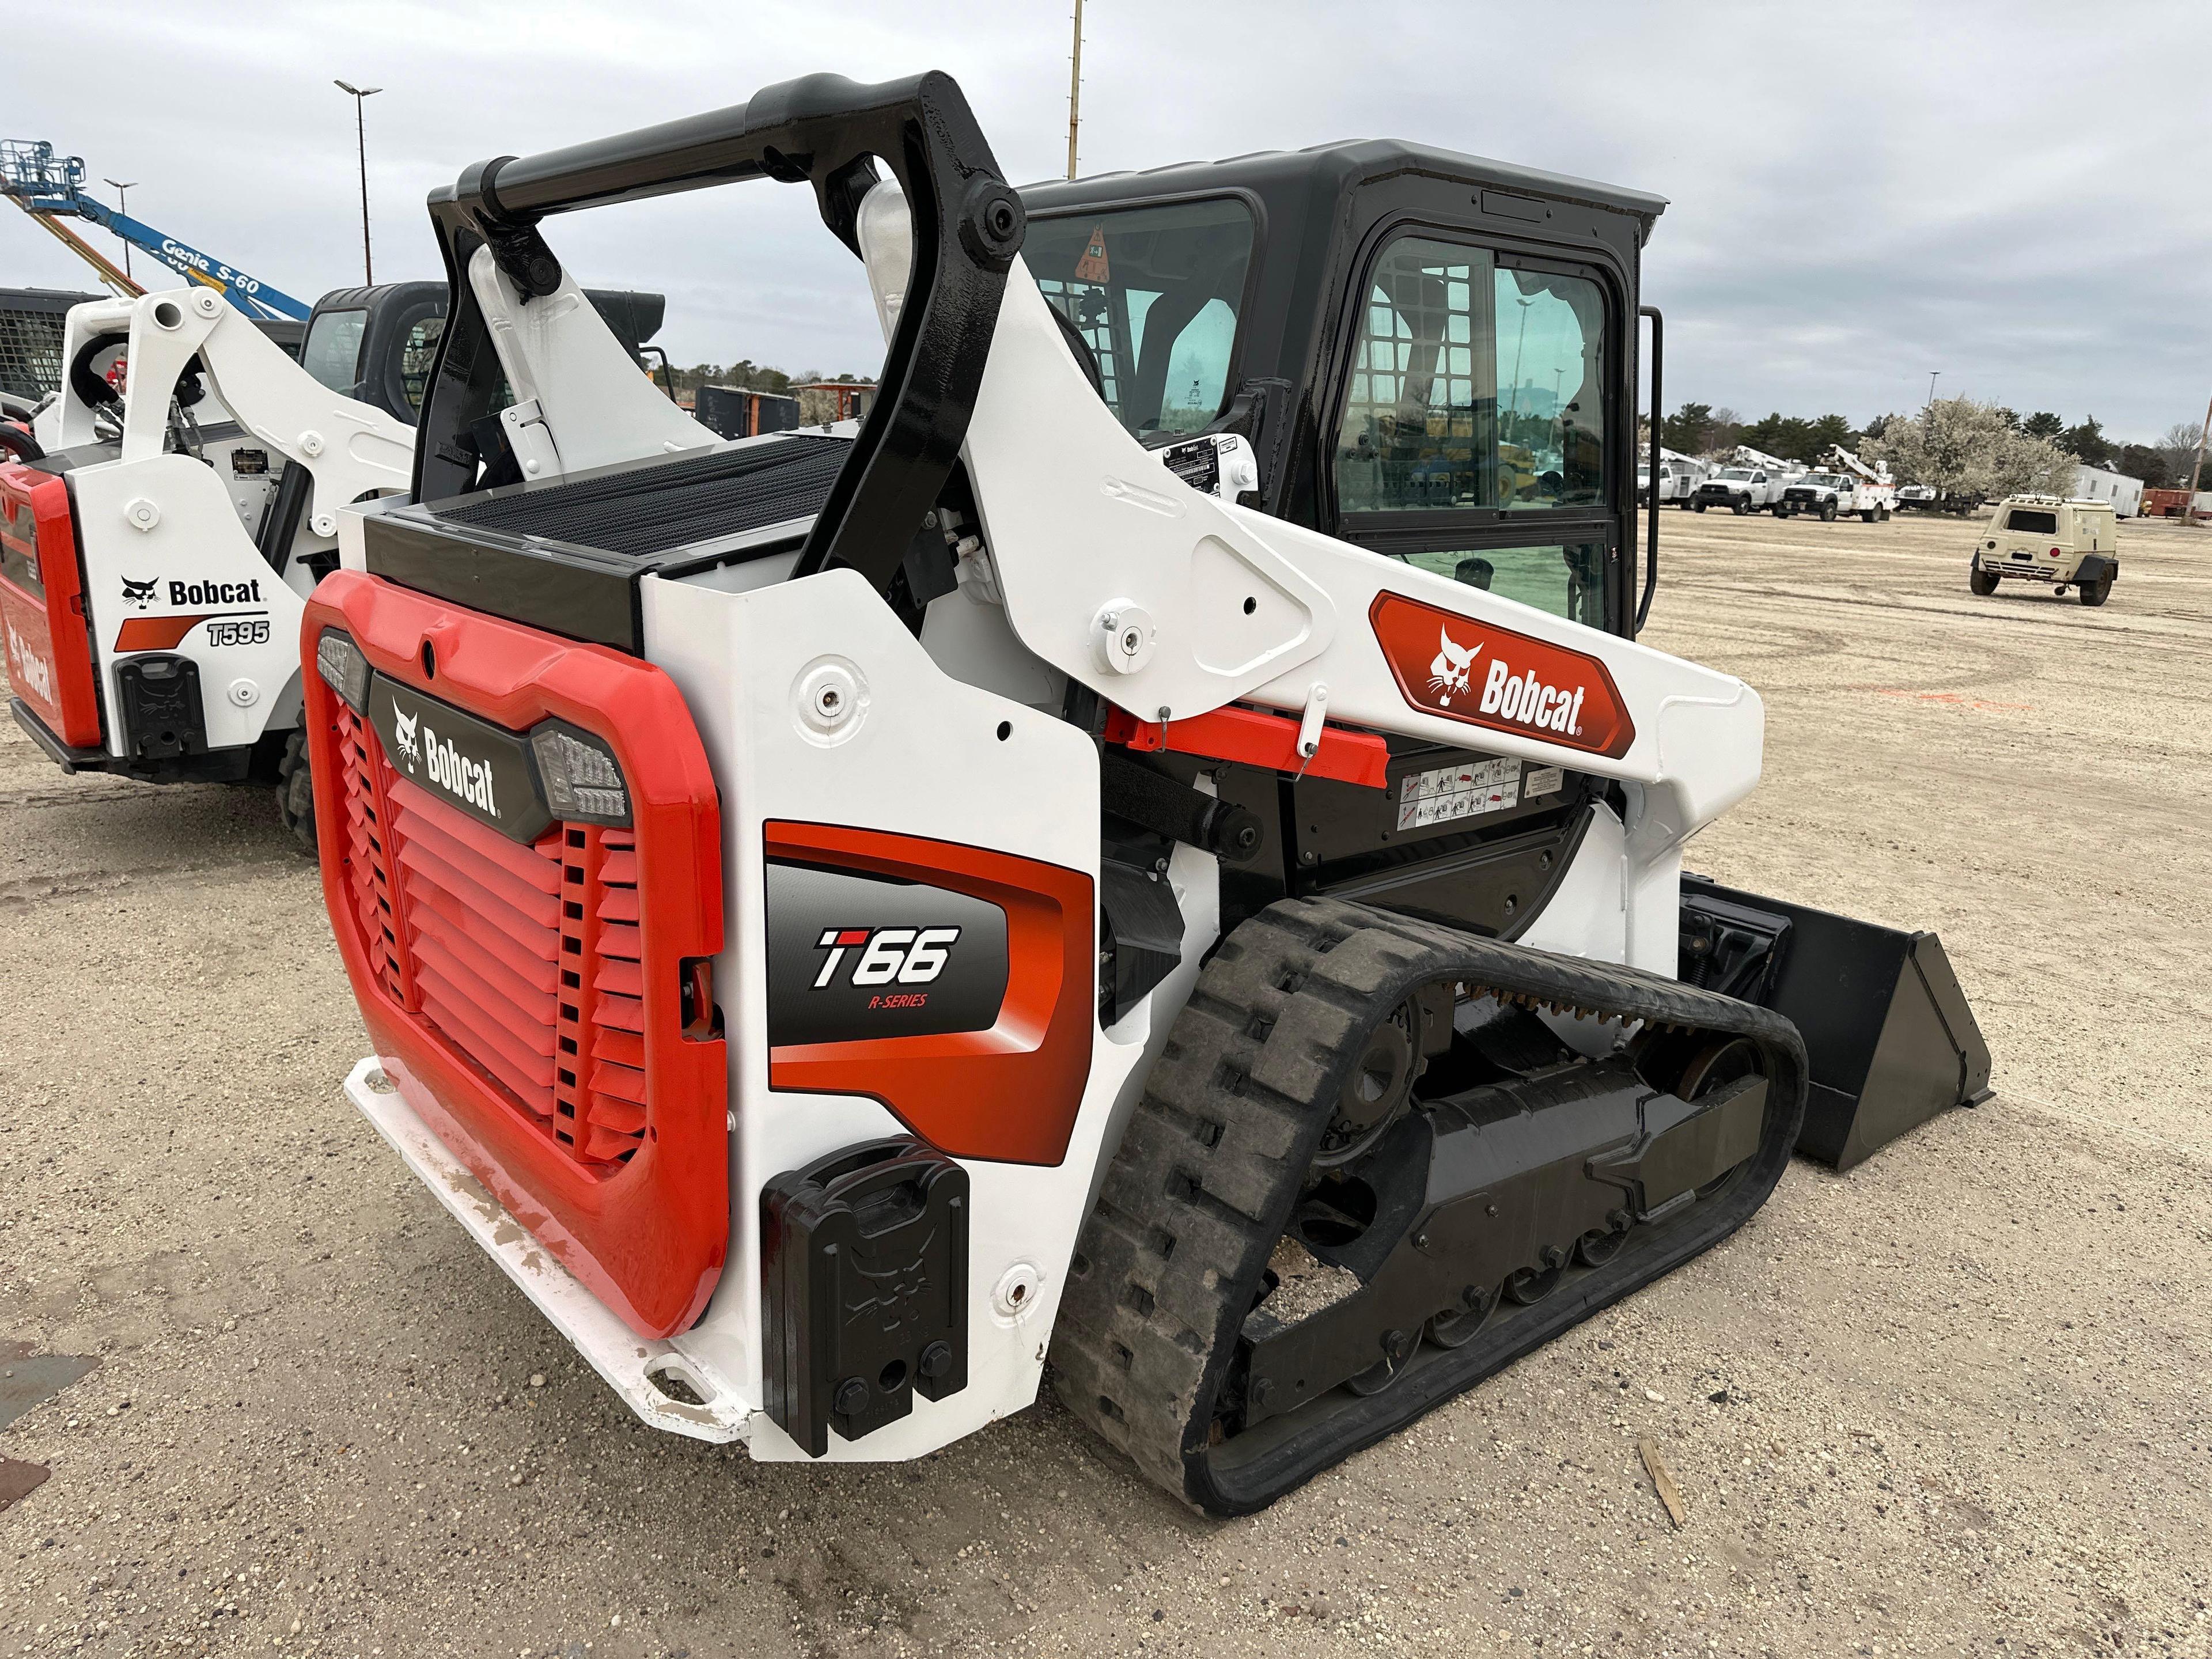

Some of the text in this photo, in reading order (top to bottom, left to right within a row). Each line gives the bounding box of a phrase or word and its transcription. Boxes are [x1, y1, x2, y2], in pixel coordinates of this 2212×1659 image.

[162, 239, 210, 271] Genie
[216, 266, 259, 294] S-60
[169, 579, 261, 606] Bobcat
[207, 620, 270, 647] T595
[1479, 658, 1585, 735] Bobcat
[423, 726, 497, 817] Bobcat
[810, 927, 960, 989] T66
[868, 994, 928, 1009] R-SERIES
